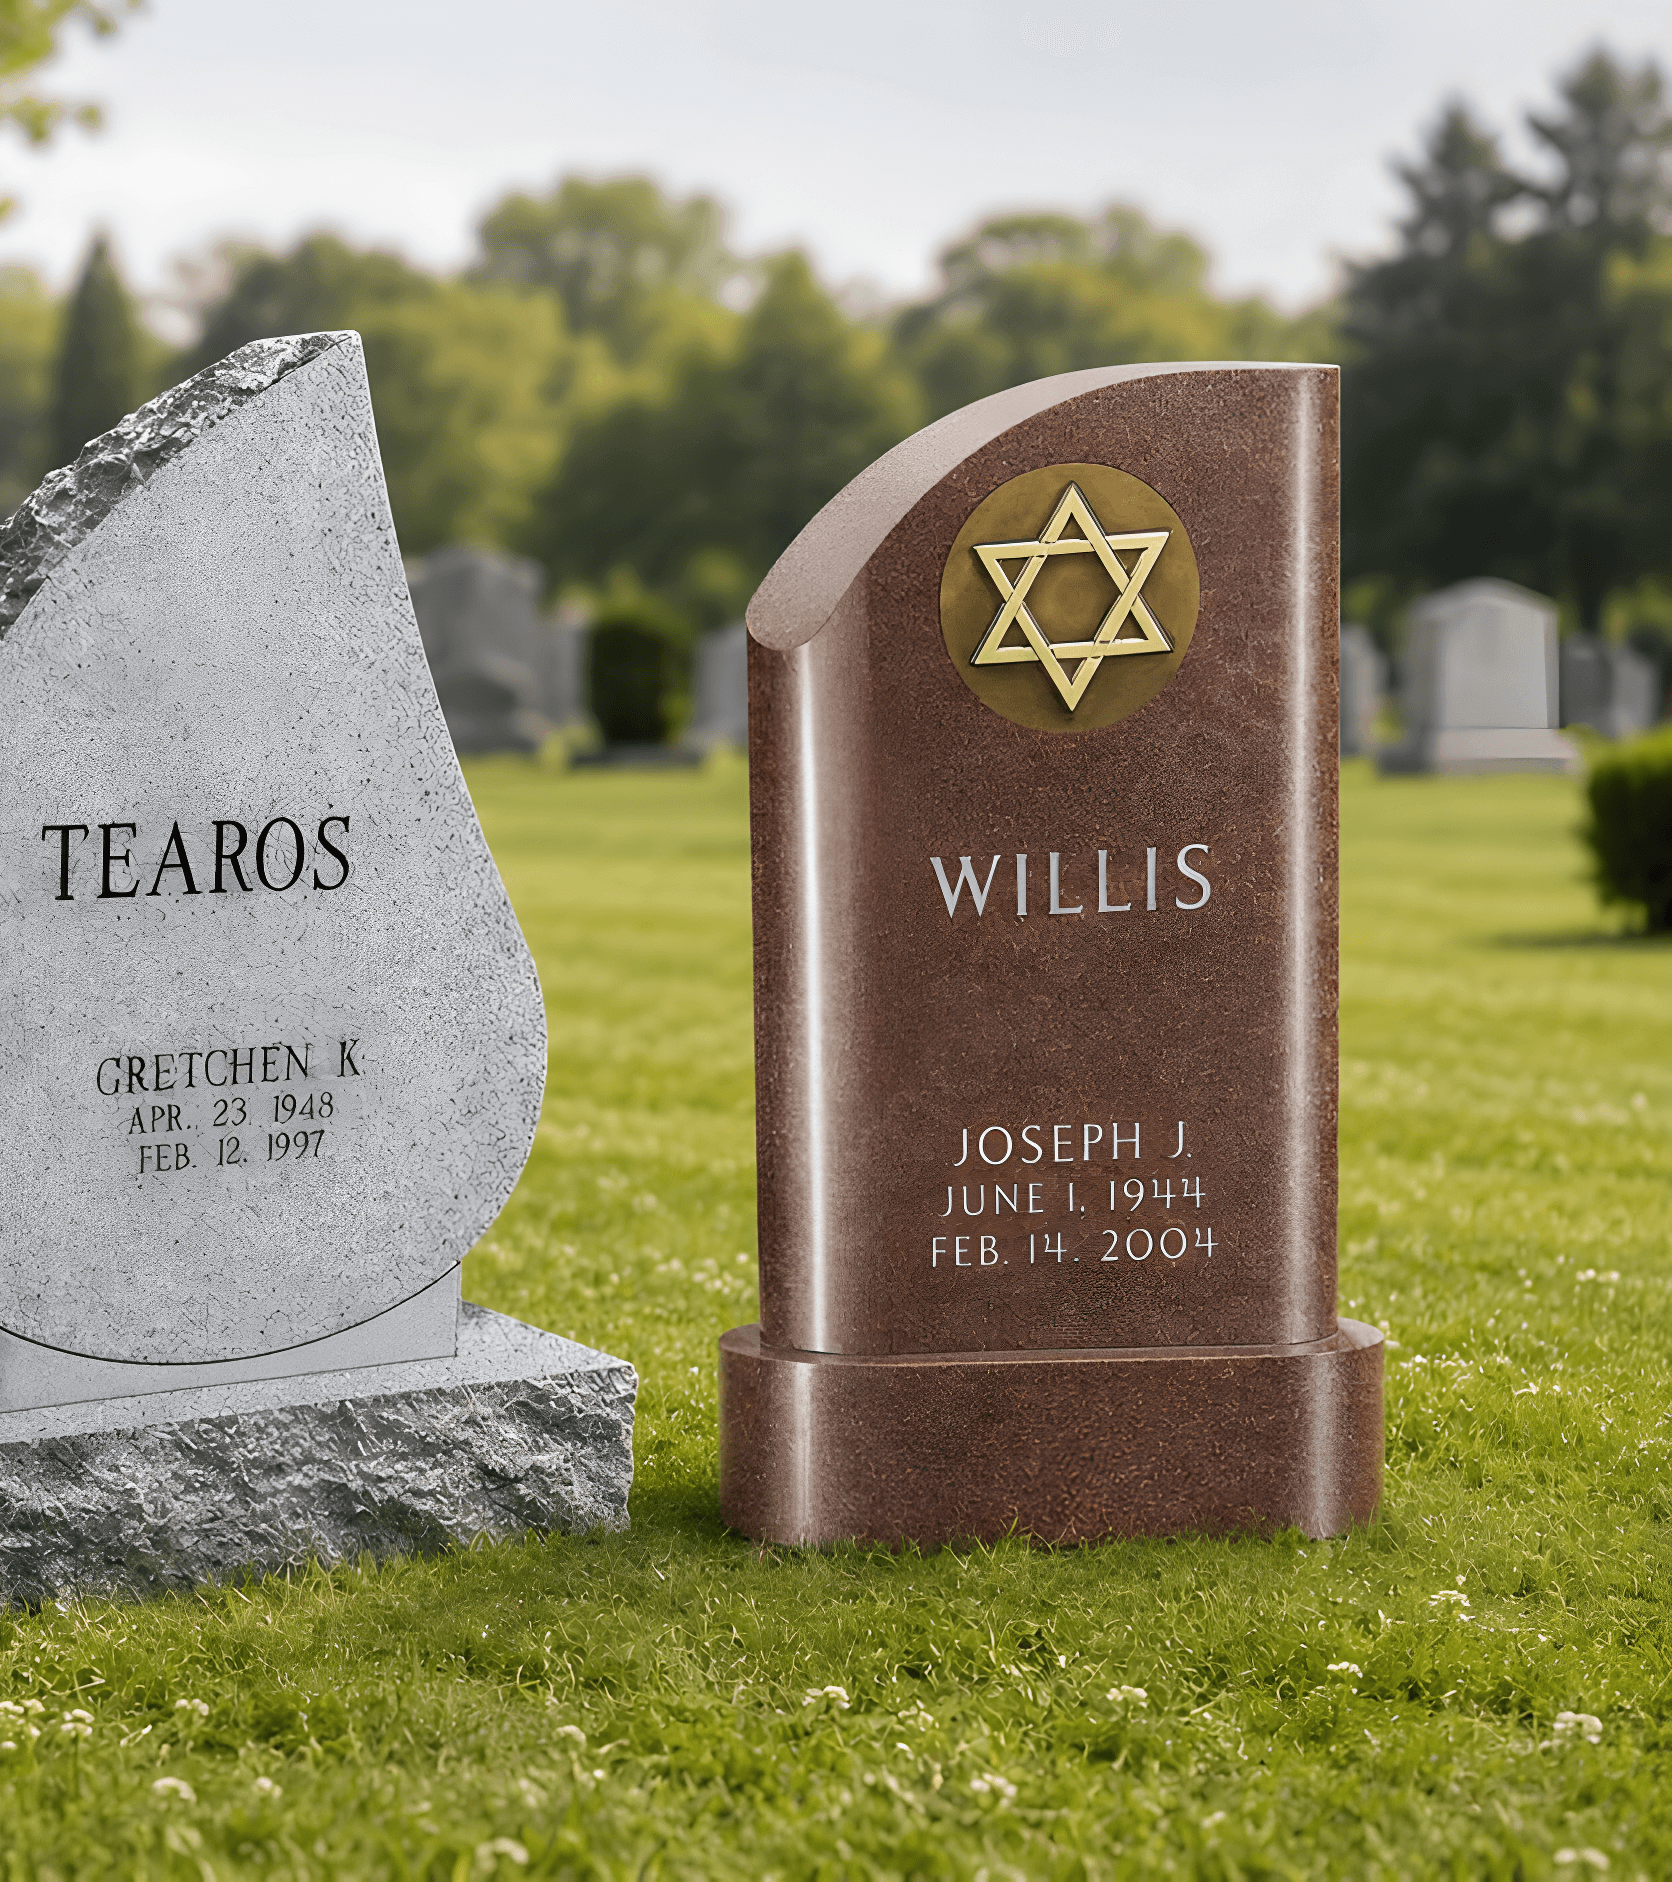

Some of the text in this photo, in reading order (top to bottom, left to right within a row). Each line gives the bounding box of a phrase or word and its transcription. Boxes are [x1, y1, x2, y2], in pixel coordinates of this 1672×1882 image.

[41, 815, 351, 901] TEAROS
[929, 843, 1212, 919] WILLIS
[96, 1041, 312, 1096] GRETCHEN
[128, 1104, 192, 1135] APR.
[273, 1091, 334, 1124] 1948
[139, 1143, 197, 1174] FEB.
[267, 1129, 325, 1162] 1997
[953, 1120, 1192, 1167] JOSEPH J.
[938, 1182, 1044, 1217] JUNE
[1110, 1176, 1206, 1212] 1944
[932, 1227, 1219, 1268] FEB. 14. 2004
